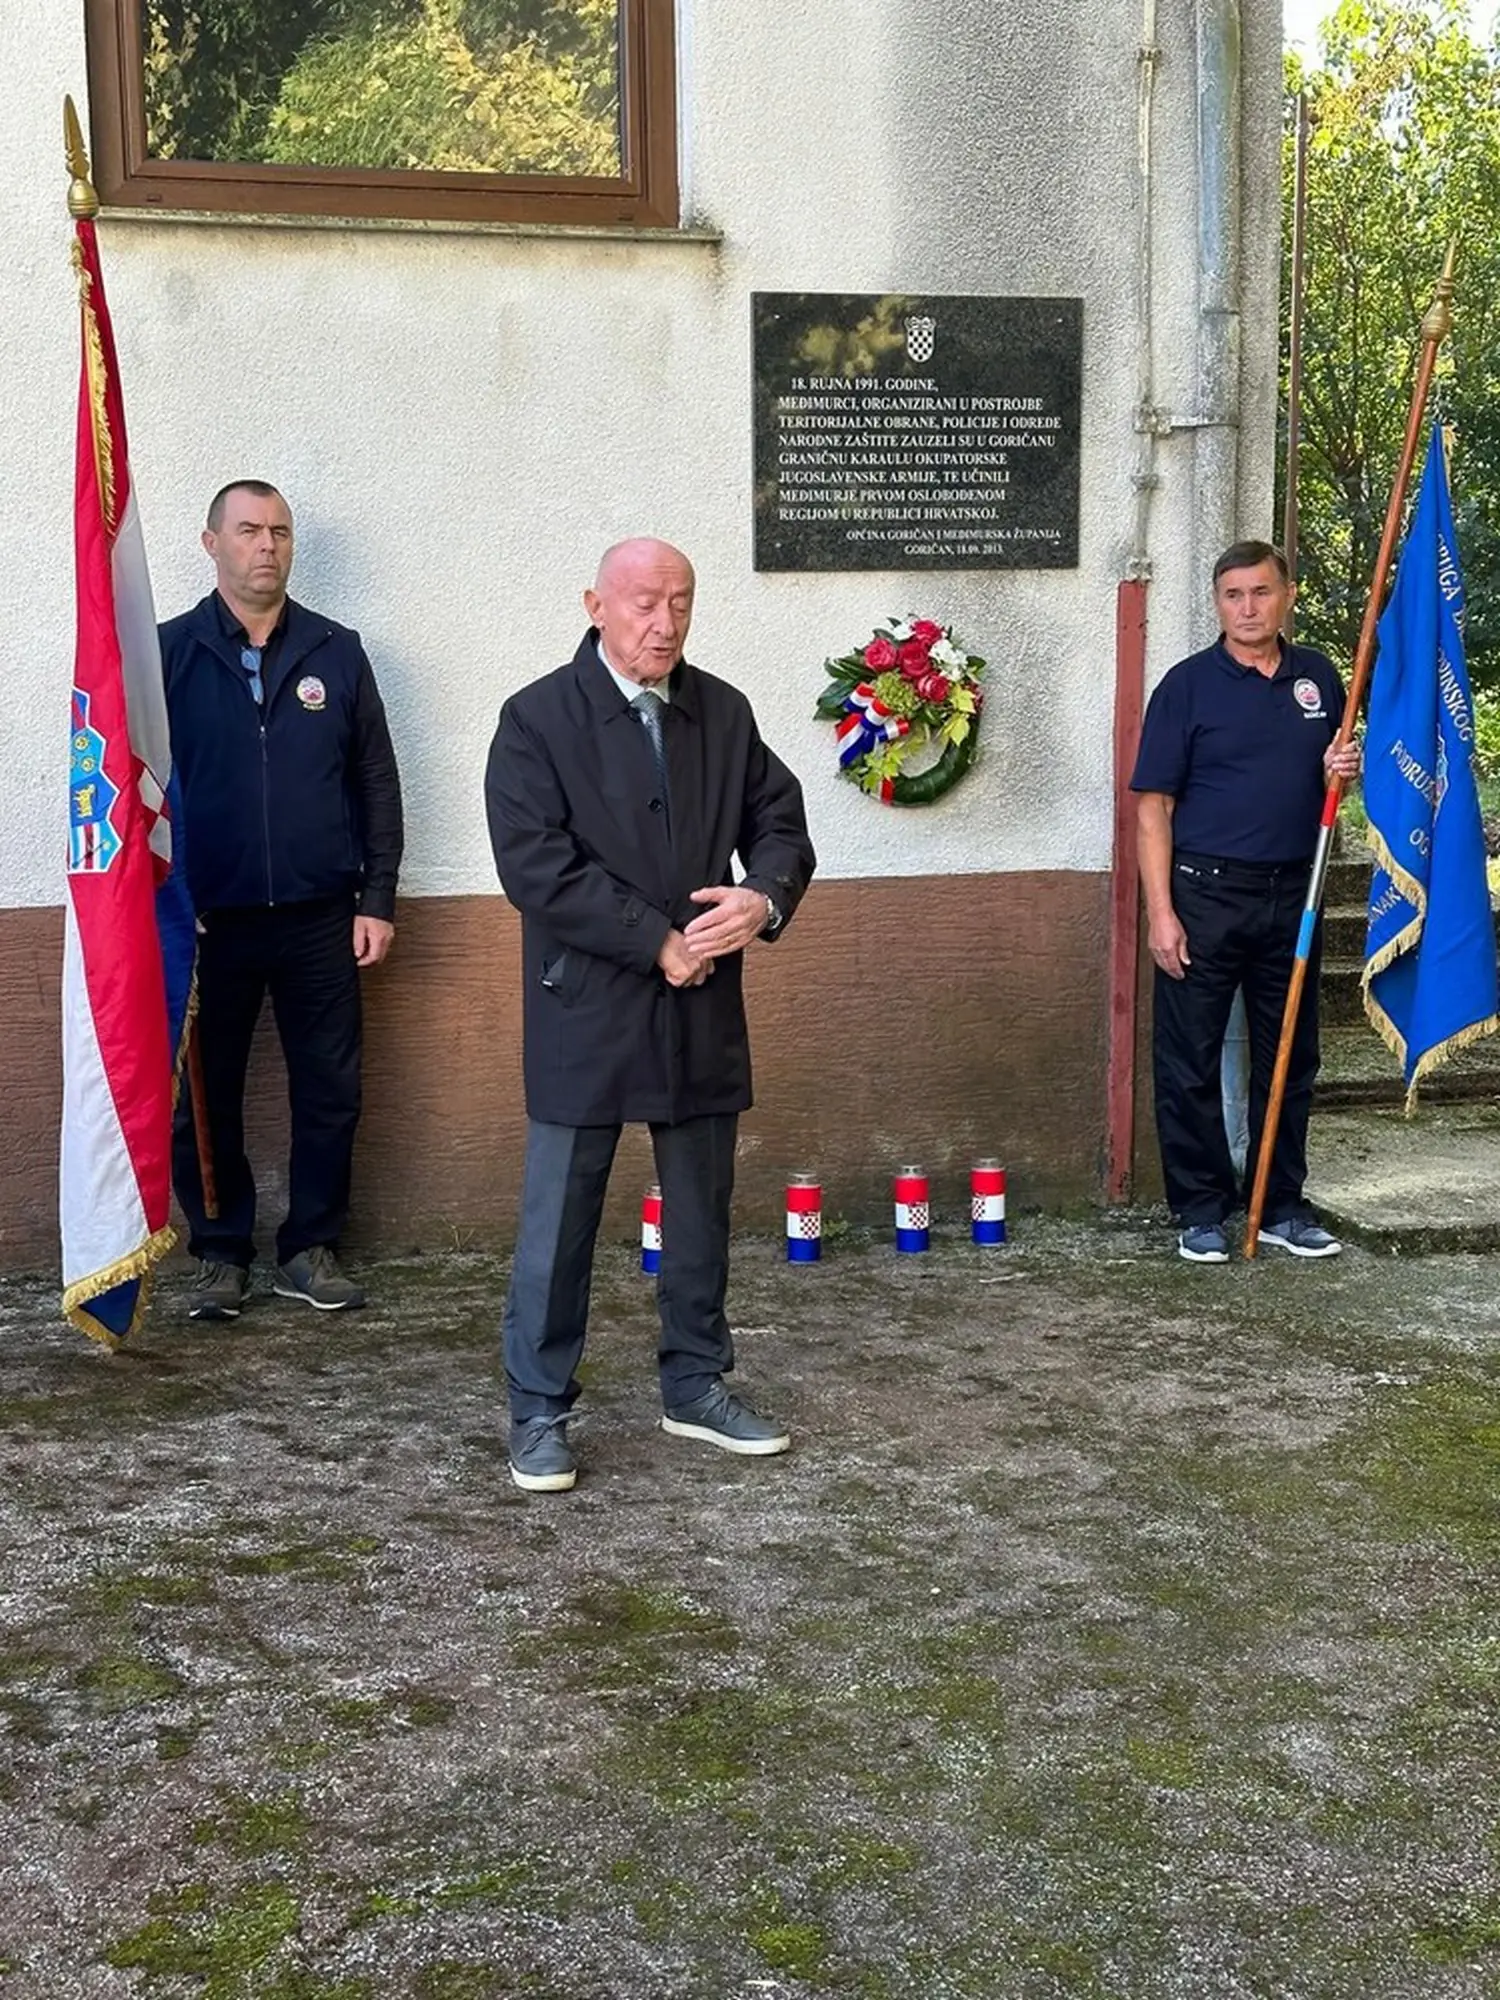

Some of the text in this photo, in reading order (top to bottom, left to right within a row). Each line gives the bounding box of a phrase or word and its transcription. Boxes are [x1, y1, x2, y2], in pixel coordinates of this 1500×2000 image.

[791, 377, 939, 392] 18. RUJNA 1991. GODINE,
[862, 397, 957, 411] ORGANIZIRANI
[960, 397, 969, 410] U
[971, 397, 1043, 411] POSTROJBE
[778, 415, 1061, 430] TERITORIJALNE OBRANE, POLICIJE I ODREDE
[778, 432, 1056, 447] NARODNE ZAŠTITE ZAUZELI SU U GORIČANU
[779, 450, 1007, 465] GRANIČNU KARAULU OKUPATORSKE
[778, 468, 1010, 484] JUGOSLAVENSKE ARMIJE, TE UČINILI
[859, 489, 905, 502] PRVOM
[778, 507, 1000, 521] REGIJOM U REPUBLICI HRVATSKOJ.
[887, 527, 935, 540] GORIČAN
